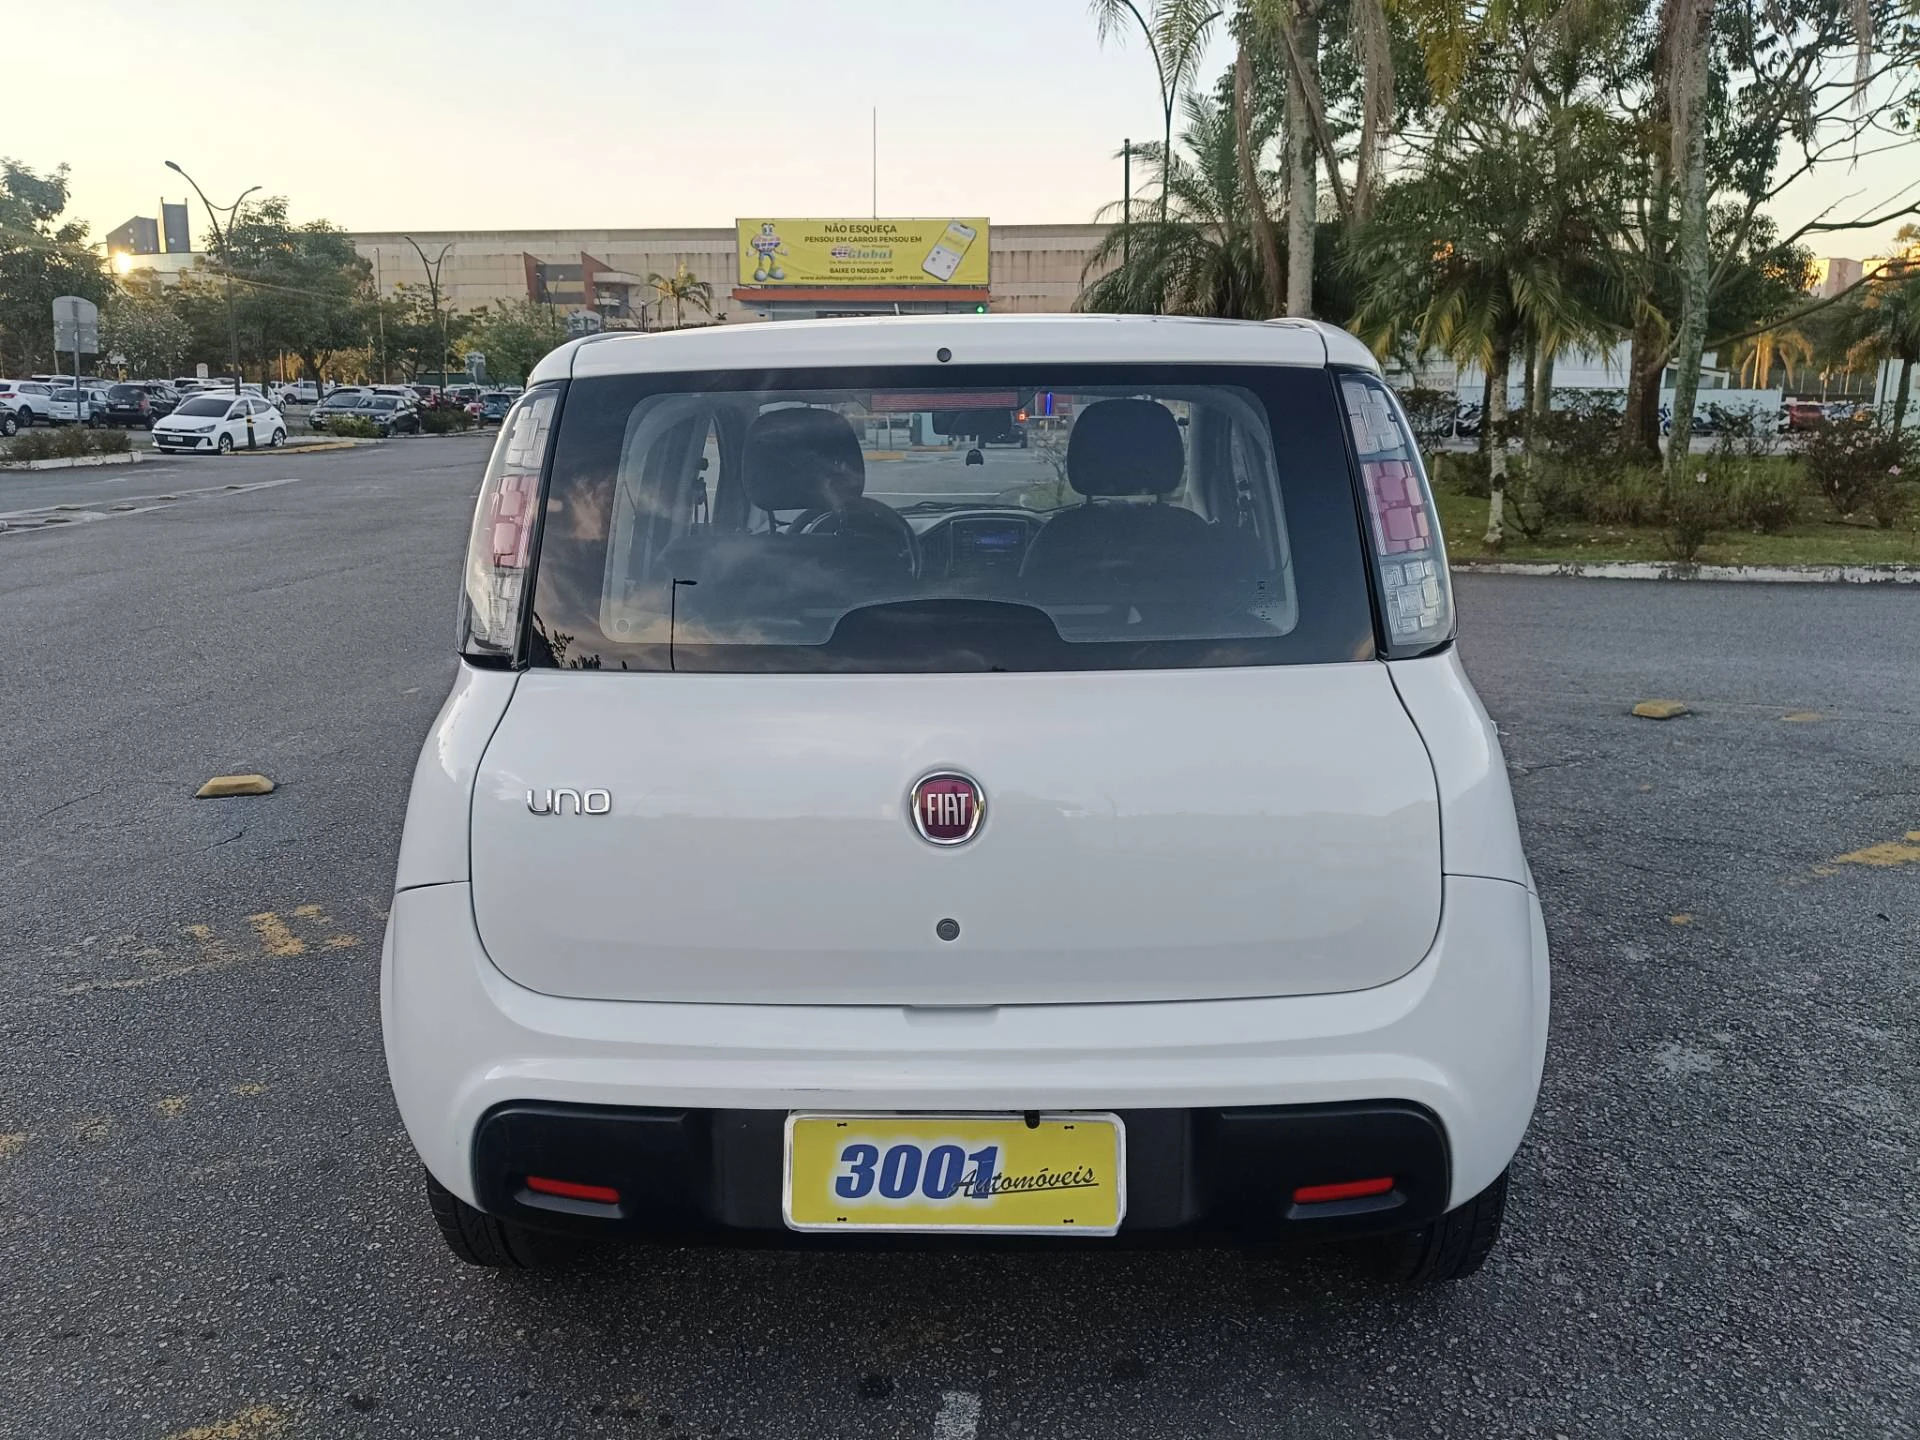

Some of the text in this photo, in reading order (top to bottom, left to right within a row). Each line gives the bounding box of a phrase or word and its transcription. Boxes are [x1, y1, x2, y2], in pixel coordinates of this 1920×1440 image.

[824, 223, 897, 235] NÃO ESQUEÇA
[848, 249, 892, 259] Global
[926, 792, 969, 826] FIAT
[834, 1143, 999, 1201] 3001
[950, 1165, 1100, 1199] Automóveis
